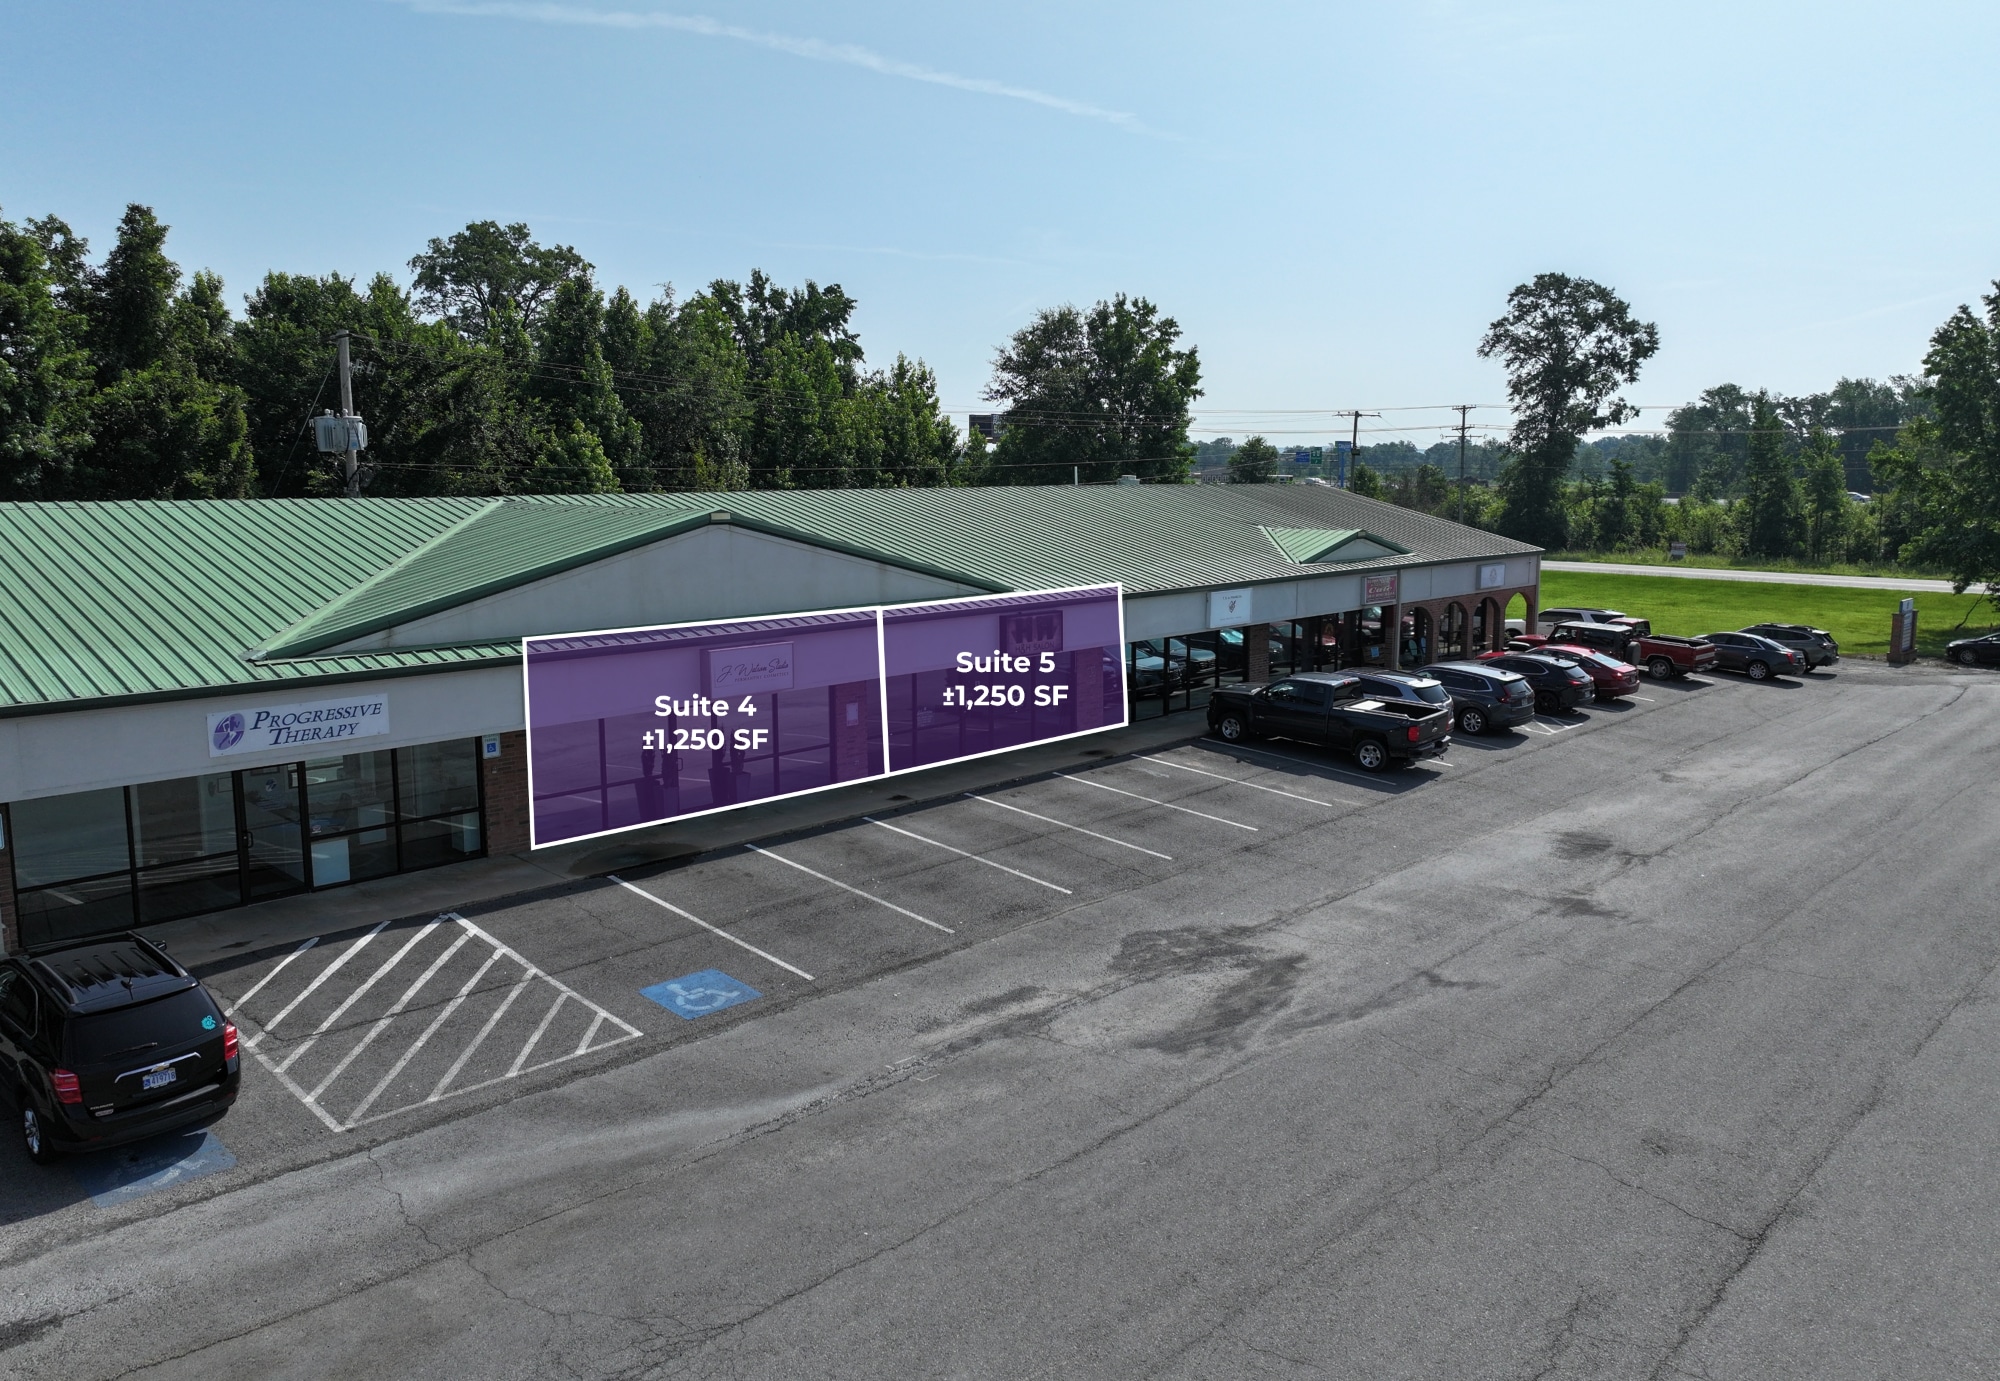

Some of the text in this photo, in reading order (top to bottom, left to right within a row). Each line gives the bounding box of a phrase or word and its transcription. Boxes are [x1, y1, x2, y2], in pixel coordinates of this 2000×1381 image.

[1033, 641, 1055, 651] SALON
[249, 702, 383, 731] PROGRESSIVE
[268, 722, 360, 746] THERAPY
